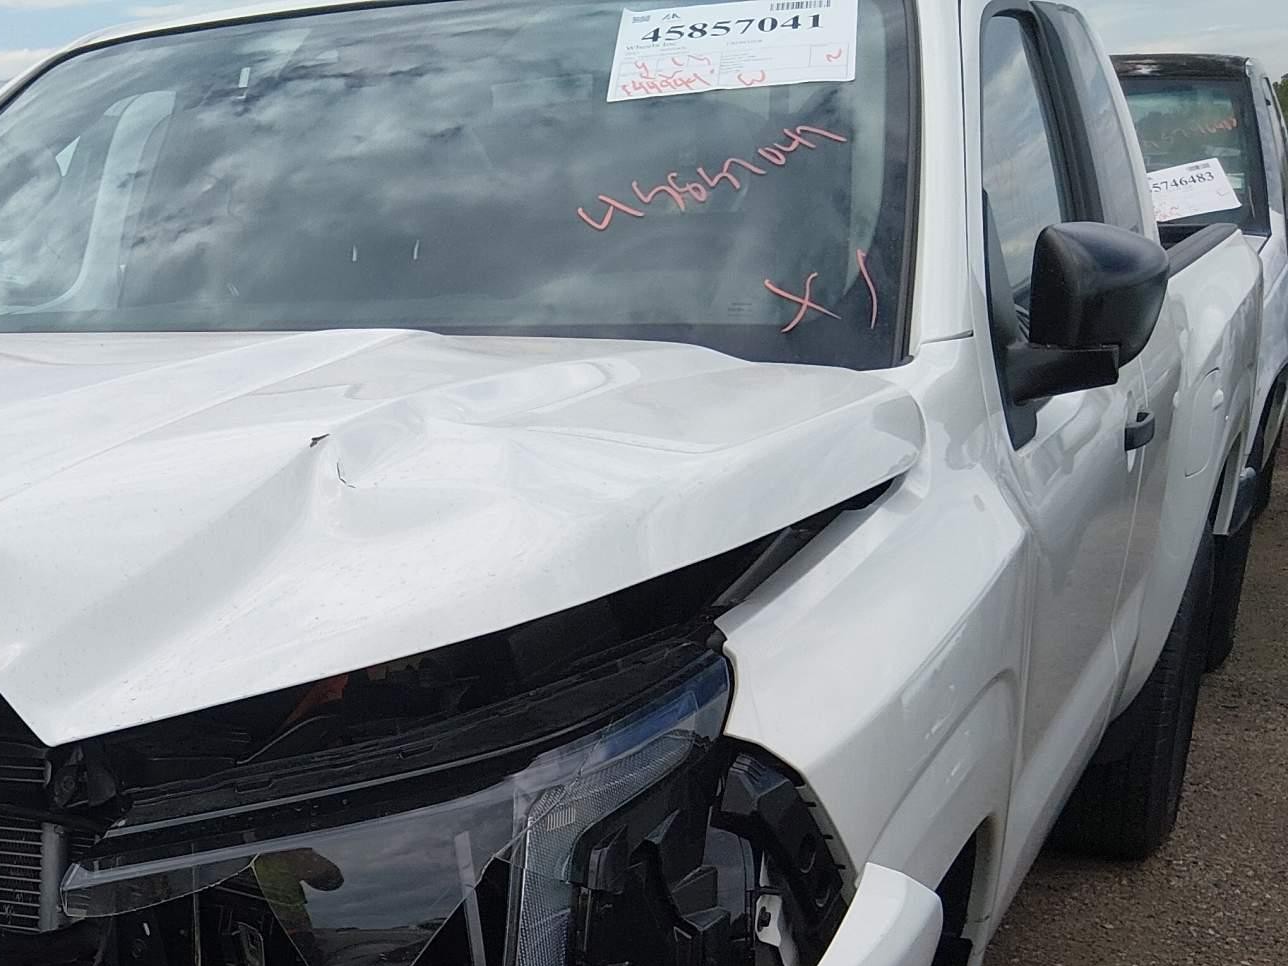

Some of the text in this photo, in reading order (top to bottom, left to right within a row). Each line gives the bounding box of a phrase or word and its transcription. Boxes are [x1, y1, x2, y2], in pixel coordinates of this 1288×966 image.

[640, 13, 824, 43] 45857041
[1150, 171, 1215, 193] 5746483
[764, 271, 843, 334] X
